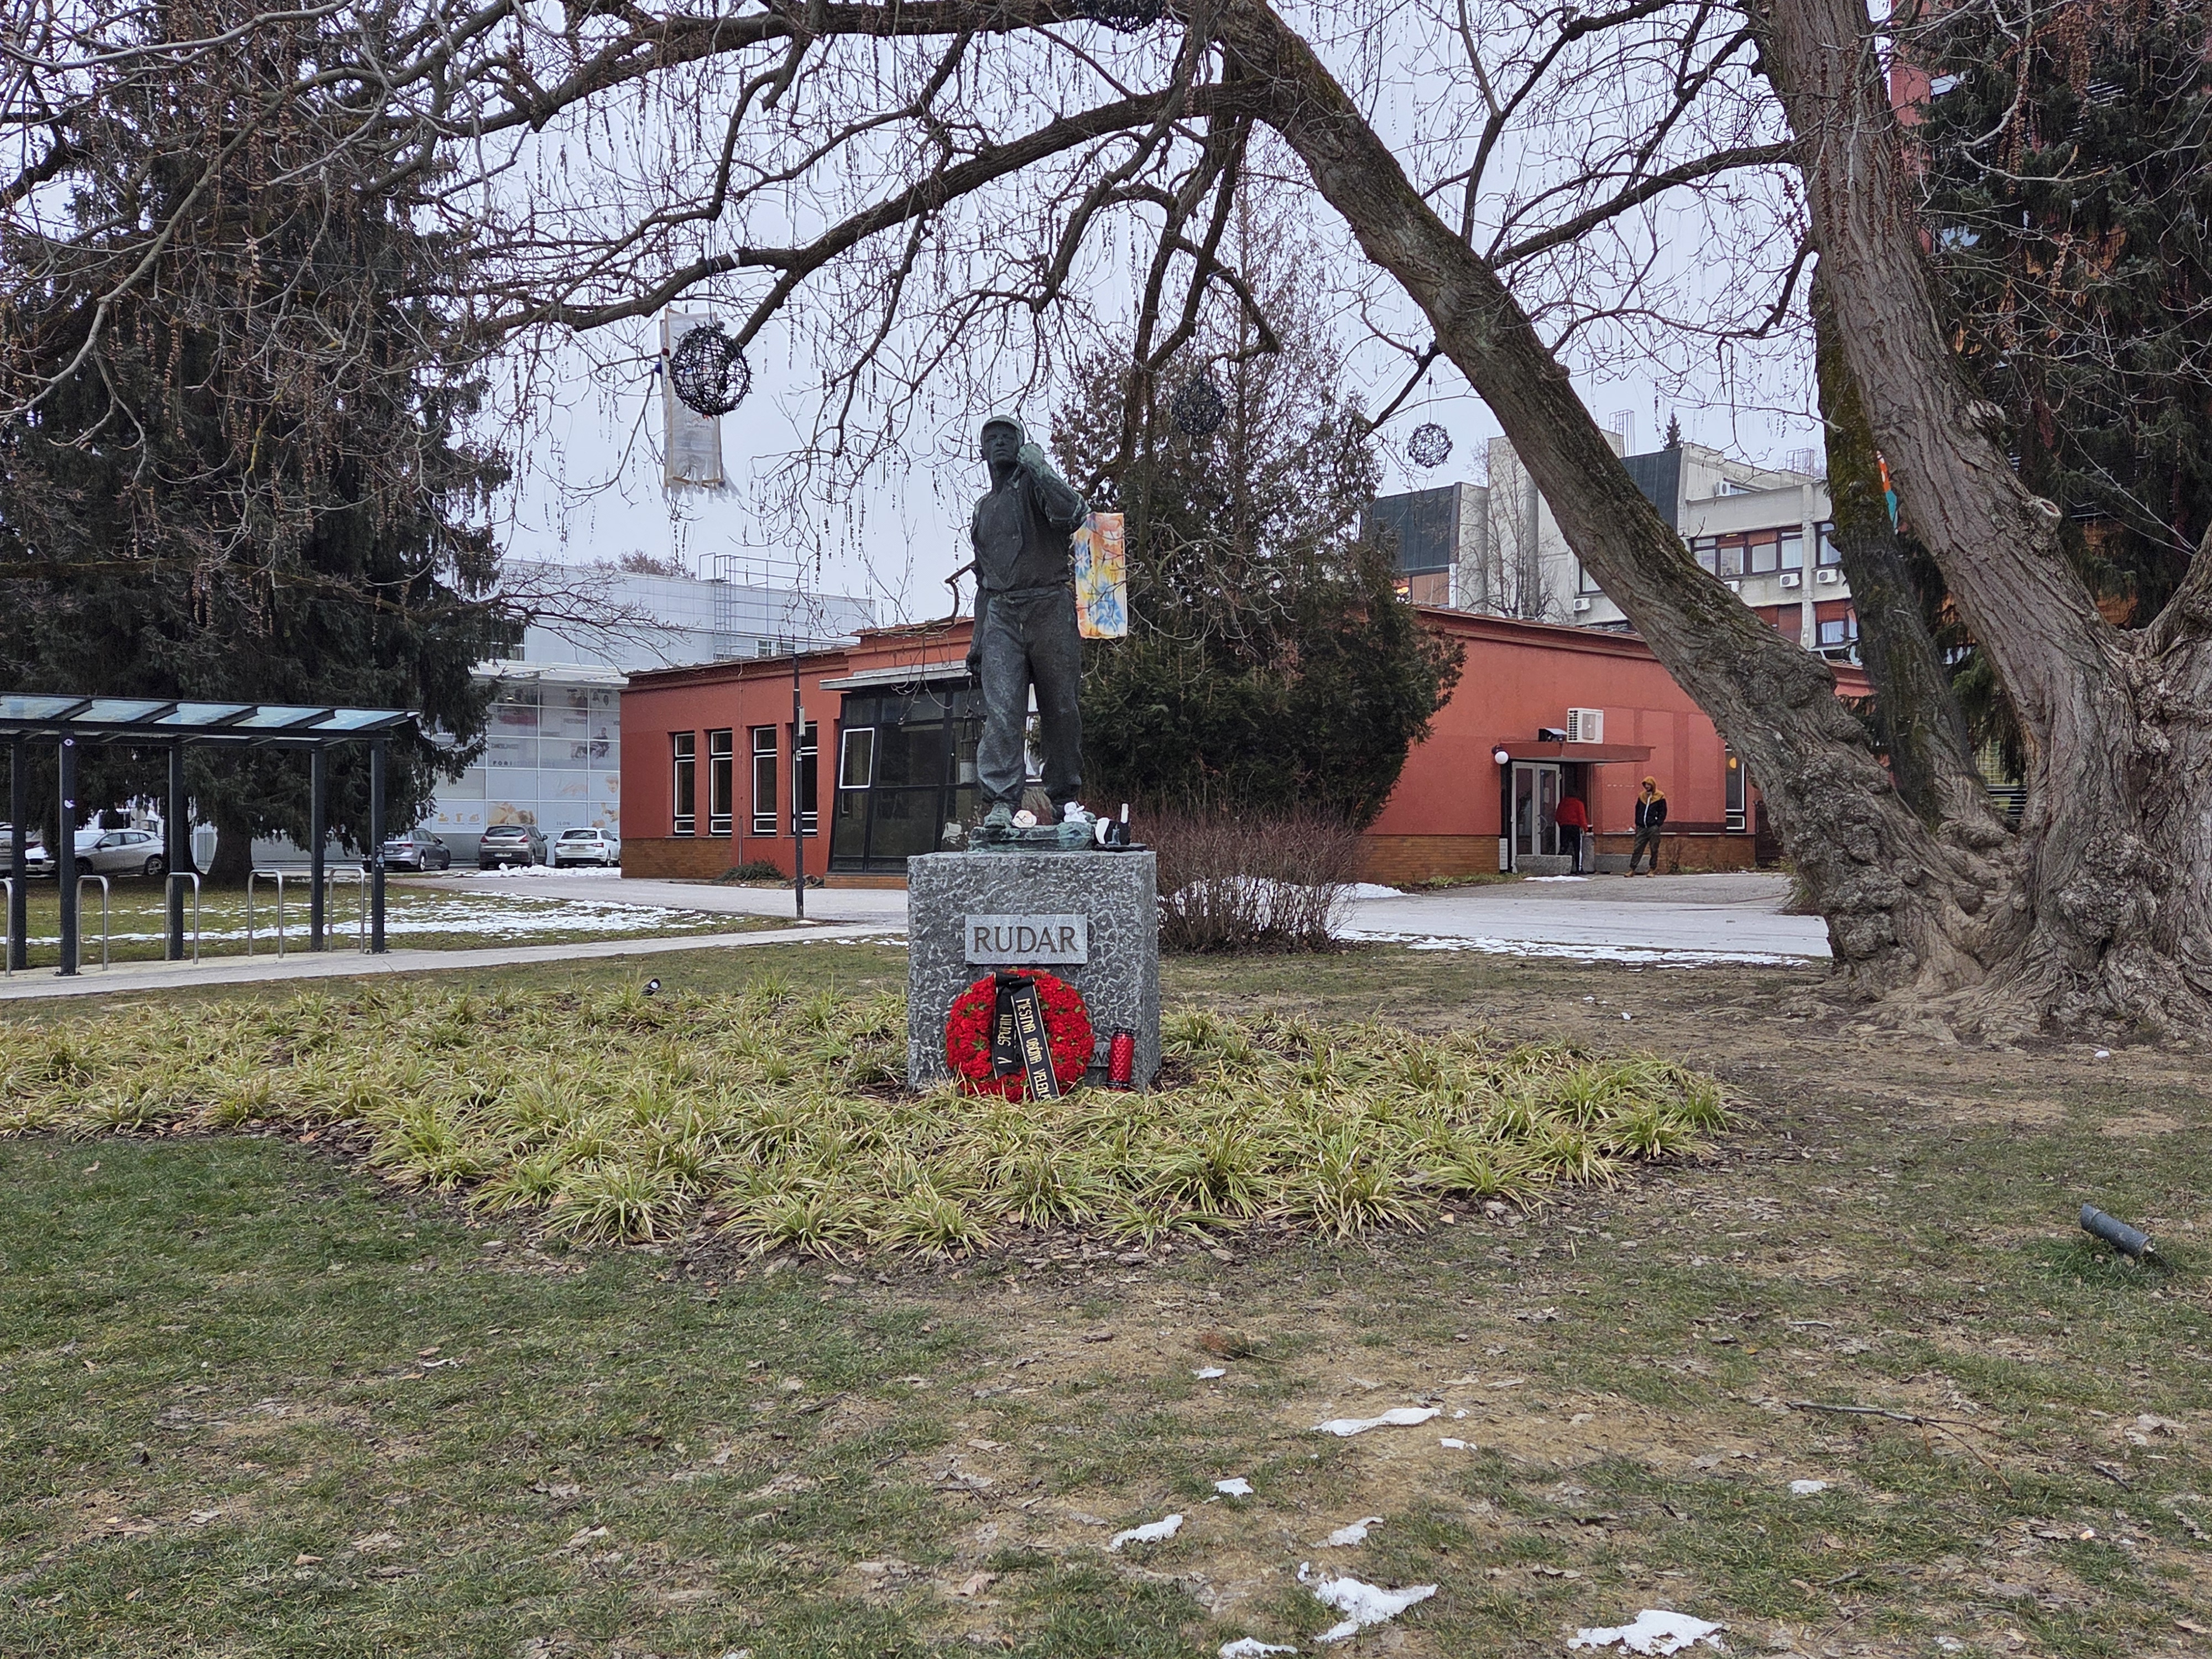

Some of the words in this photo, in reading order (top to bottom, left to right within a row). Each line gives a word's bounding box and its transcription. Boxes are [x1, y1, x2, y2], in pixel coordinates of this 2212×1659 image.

[973, 926, 1078, 952] RUDAR
[997, 1014, 1013, 1047] SPOMIN
[1015, 998, 1036, 1034] MESTNA
[1026, 1037, 1043, 1065] OBČINA
